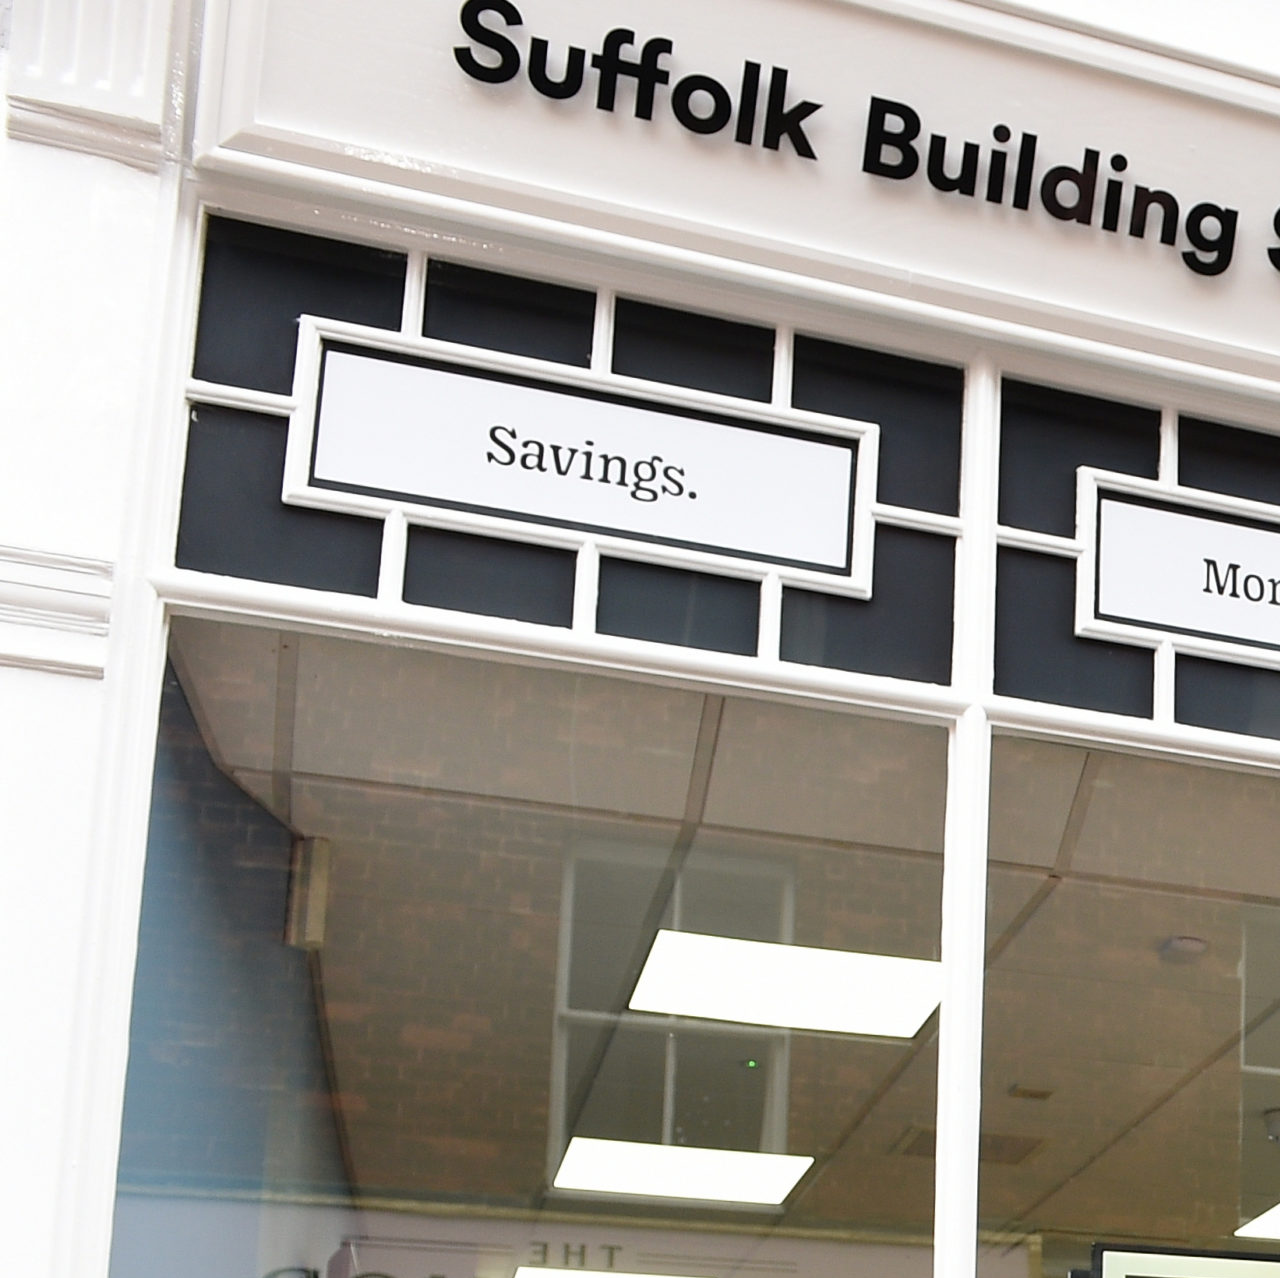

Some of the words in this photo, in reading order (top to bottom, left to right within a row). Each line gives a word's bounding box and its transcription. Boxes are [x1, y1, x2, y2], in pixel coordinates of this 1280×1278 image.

[453, 0, 823, 161] Suffolk
[862, 96, 1239, 277] Building
[486, 425, 698, 502] Savings.
